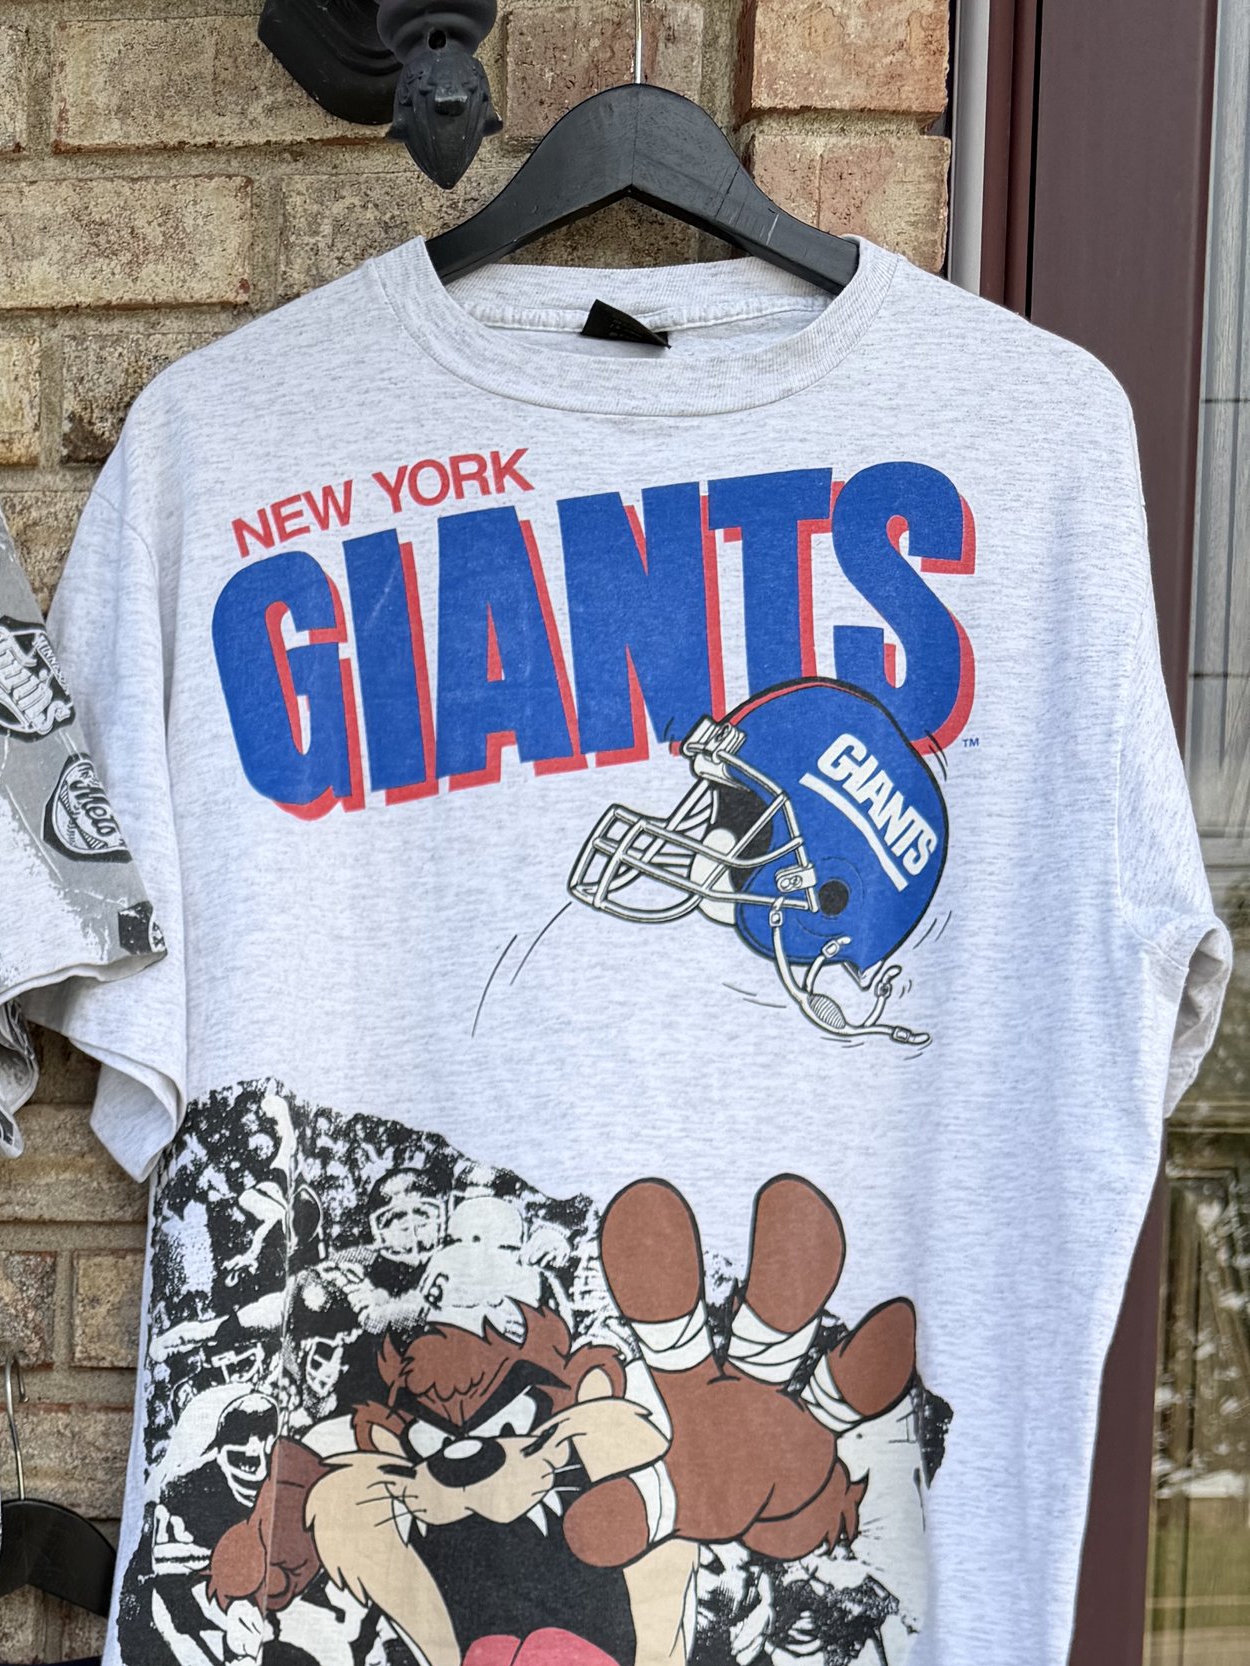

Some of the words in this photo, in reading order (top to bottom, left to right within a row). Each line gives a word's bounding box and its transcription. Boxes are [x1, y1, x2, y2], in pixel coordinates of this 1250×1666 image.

[231, 479, 353, 558] NEW
[372, 447, 535, 514] YORK
[211, 461, 975, 822] GIANTS
[817, 733, 938, 876] GIANTS
